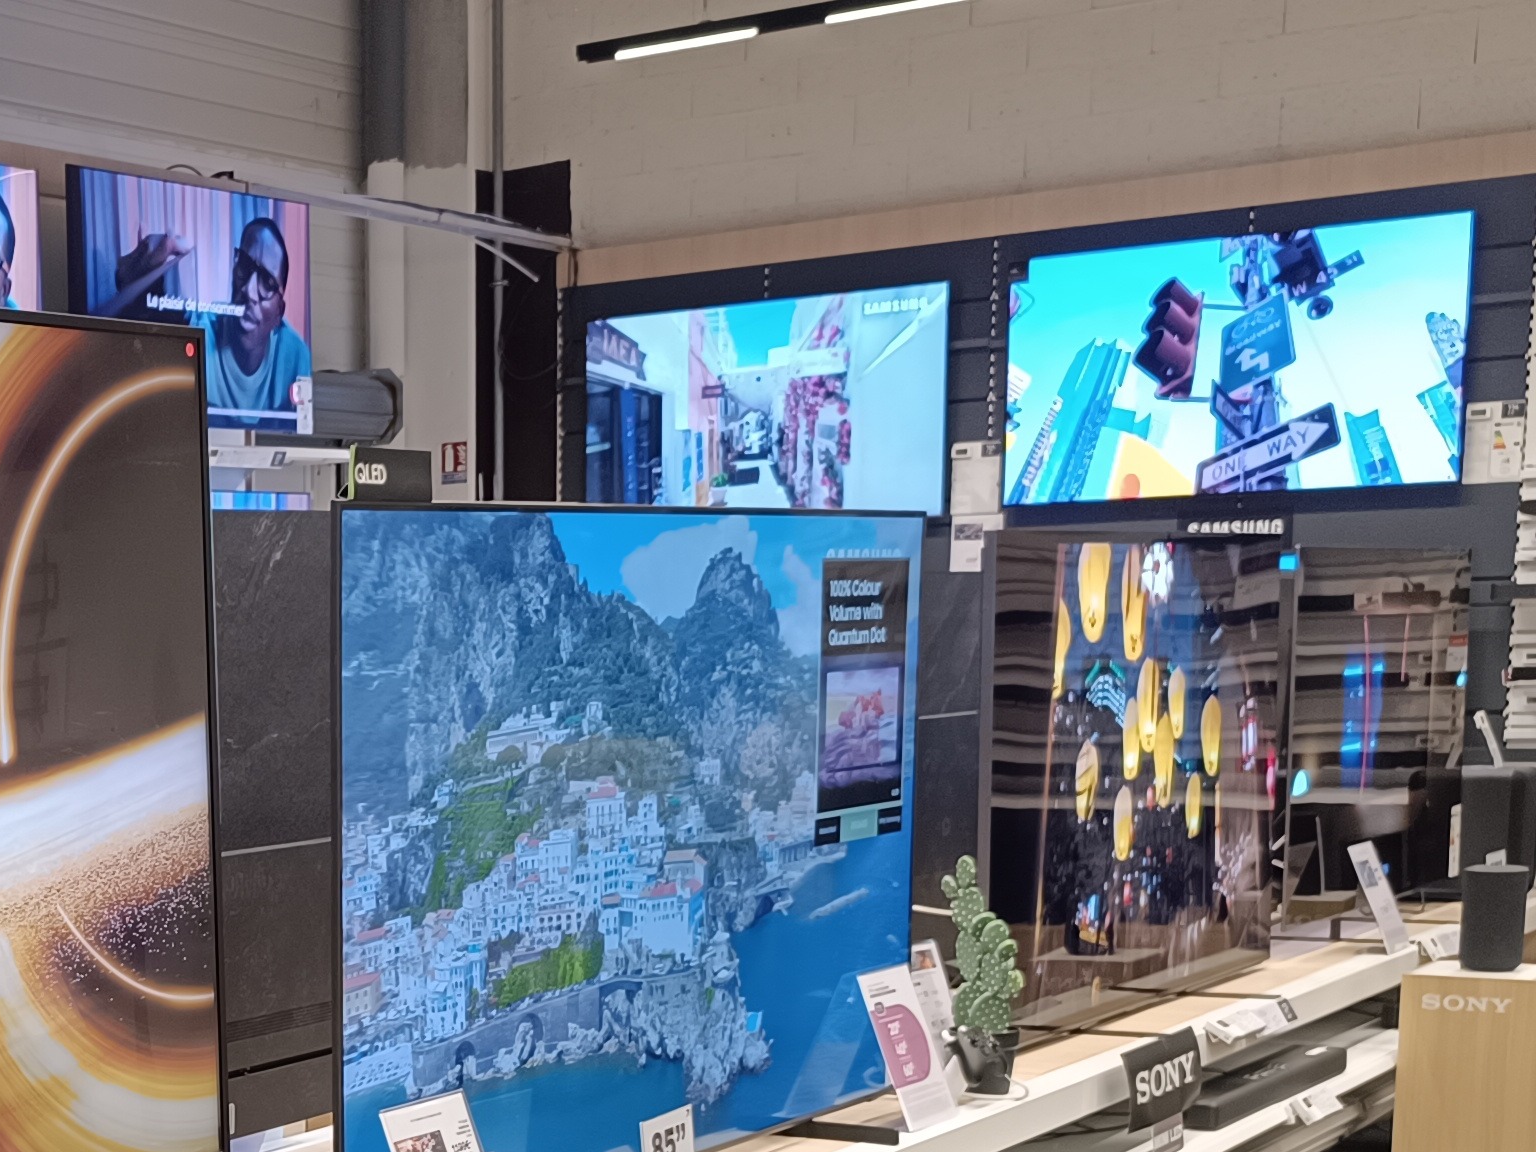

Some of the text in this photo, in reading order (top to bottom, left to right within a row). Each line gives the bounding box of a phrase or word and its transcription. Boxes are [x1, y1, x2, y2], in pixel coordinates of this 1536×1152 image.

[1267, 426, 1309, 457] WAY
[354, 463, 387, 484] QLED
[1187, 518, 1284, 535] SAMSUNG
[852, 578, 882, 596] Colour
[863, 603, 883, 621] with
[869, 625, 887, 644] Dot
[1421, 993, 1512, 1013] SONY
[1135, 1050, 1195, 1105] SONY
